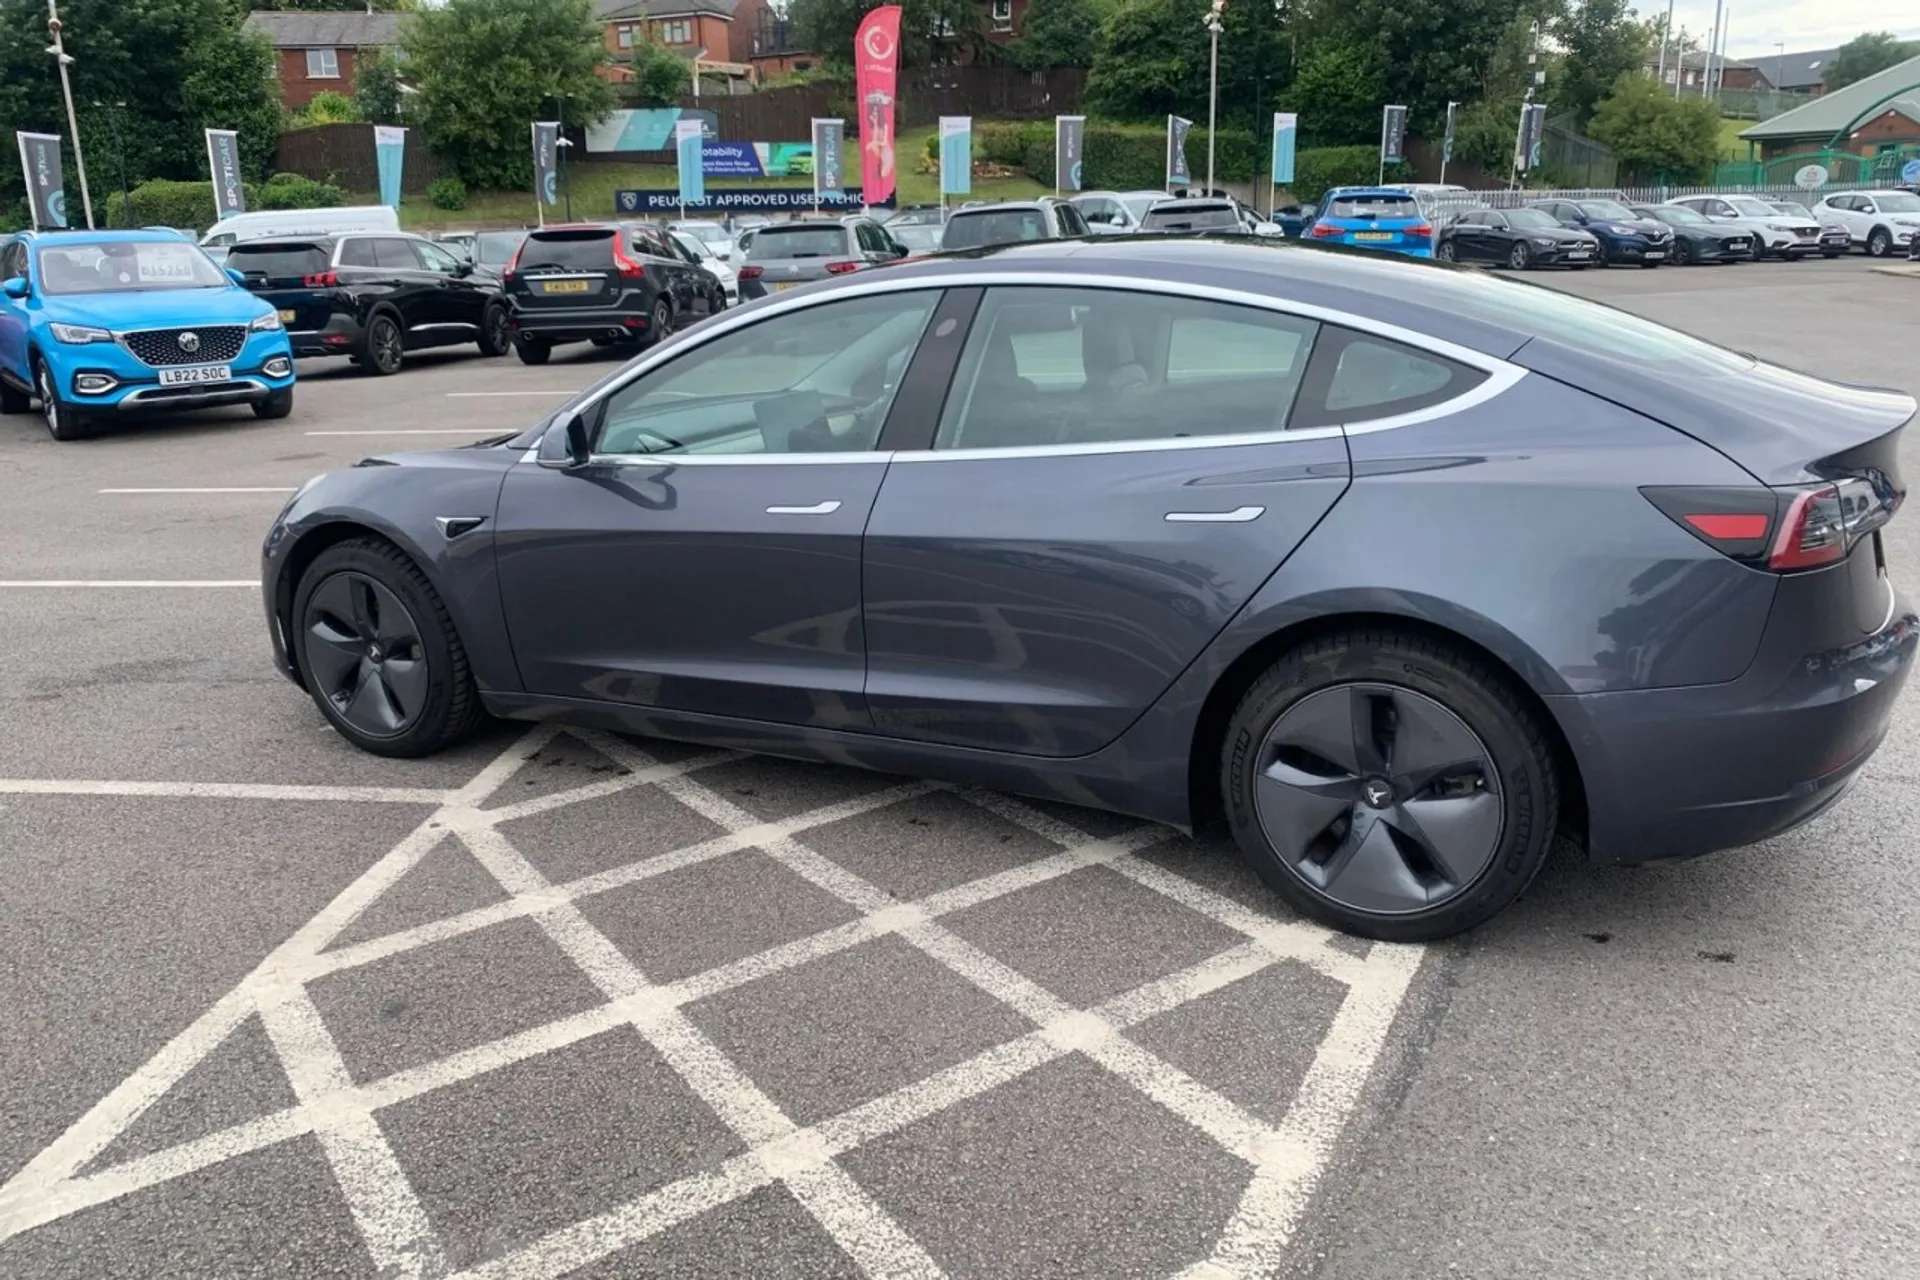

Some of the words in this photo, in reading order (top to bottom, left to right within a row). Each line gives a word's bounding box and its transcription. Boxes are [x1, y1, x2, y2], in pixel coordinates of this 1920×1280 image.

[702, 147, 743, 158] otability
[825, 126, 838, 188] SPOTICAR
[218, 136, 238, 207] SPOTICAR
[716, 194, 788, 206] APPROVED
[790, 193, 825, 205] USED
[828, 192, 889, 204] VEHIC
[165, 369, 199, 382] LB22
[201, 367, 226, 380] SOC
